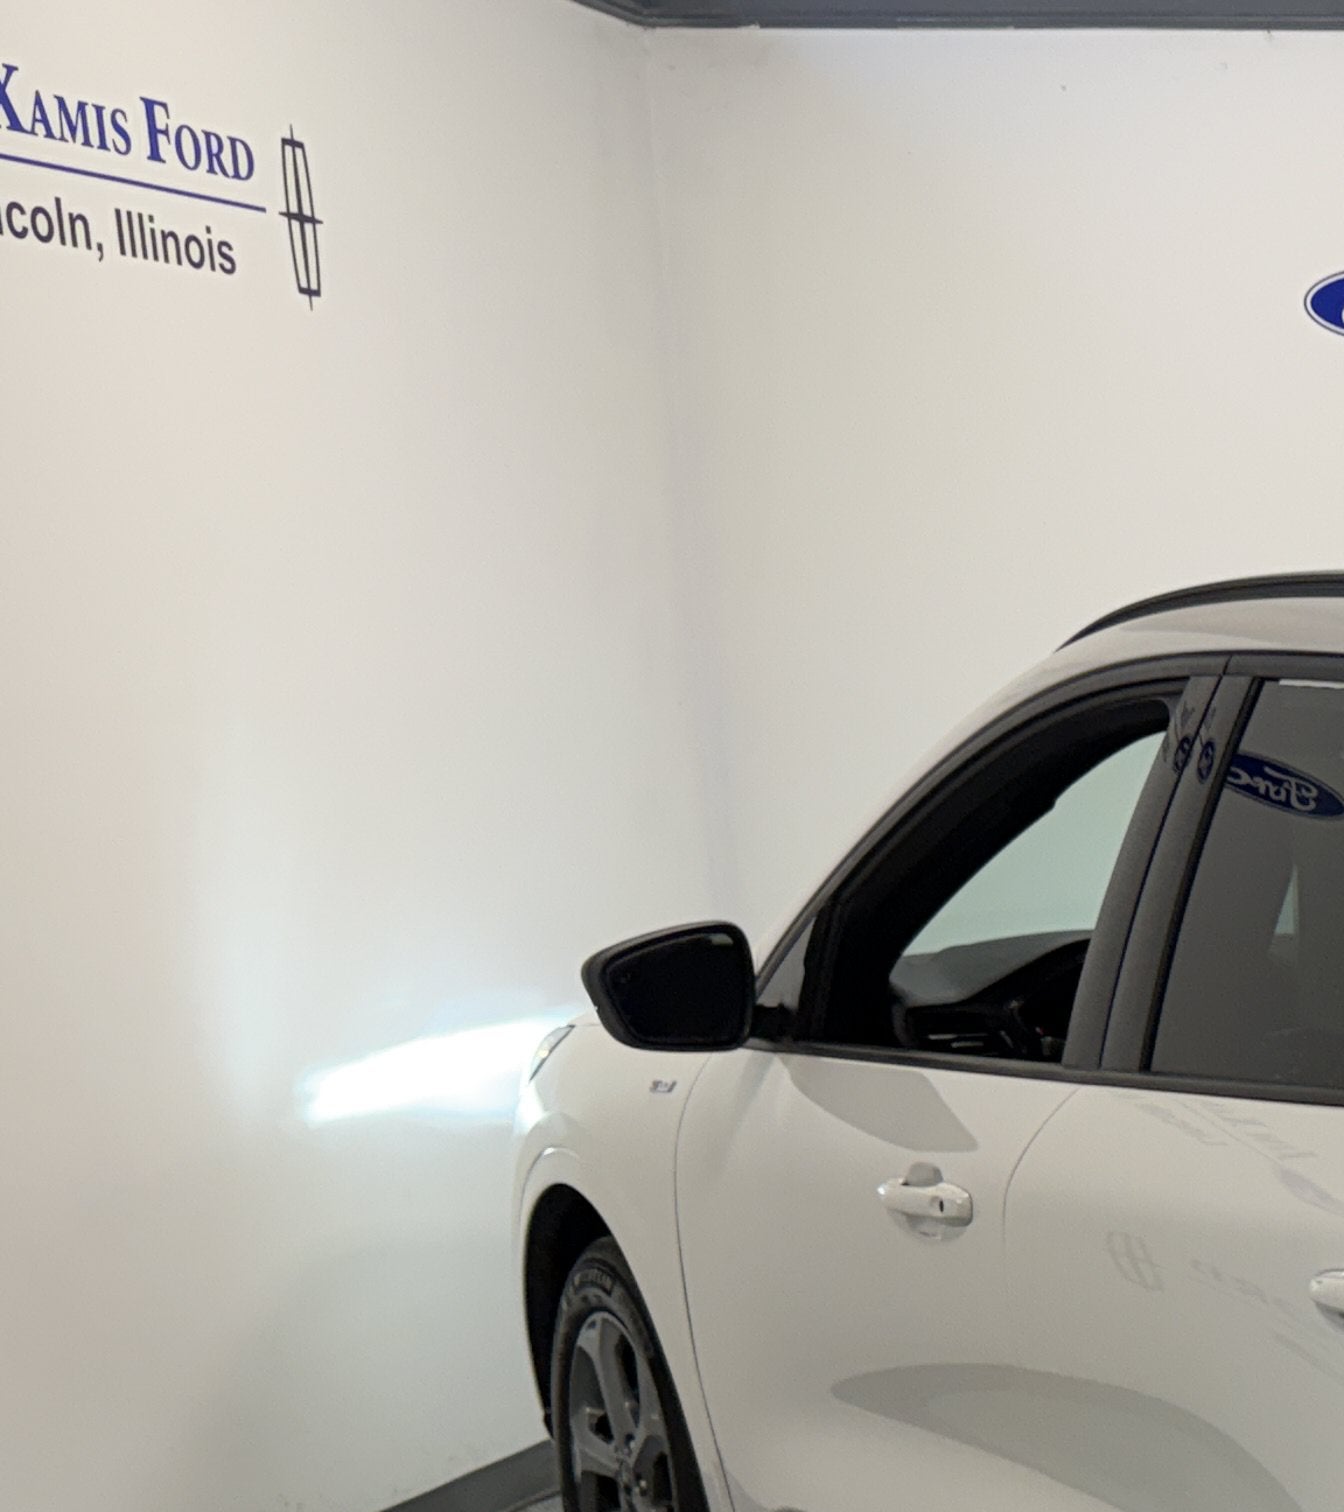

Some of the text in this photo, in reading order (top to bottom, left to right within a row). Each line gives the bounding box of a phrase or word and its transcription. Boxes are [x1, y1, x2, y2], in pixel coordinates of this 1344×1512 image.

[139, 96, 255, 181] FORD
[0, 196, 237, 275] coln, Illinois
